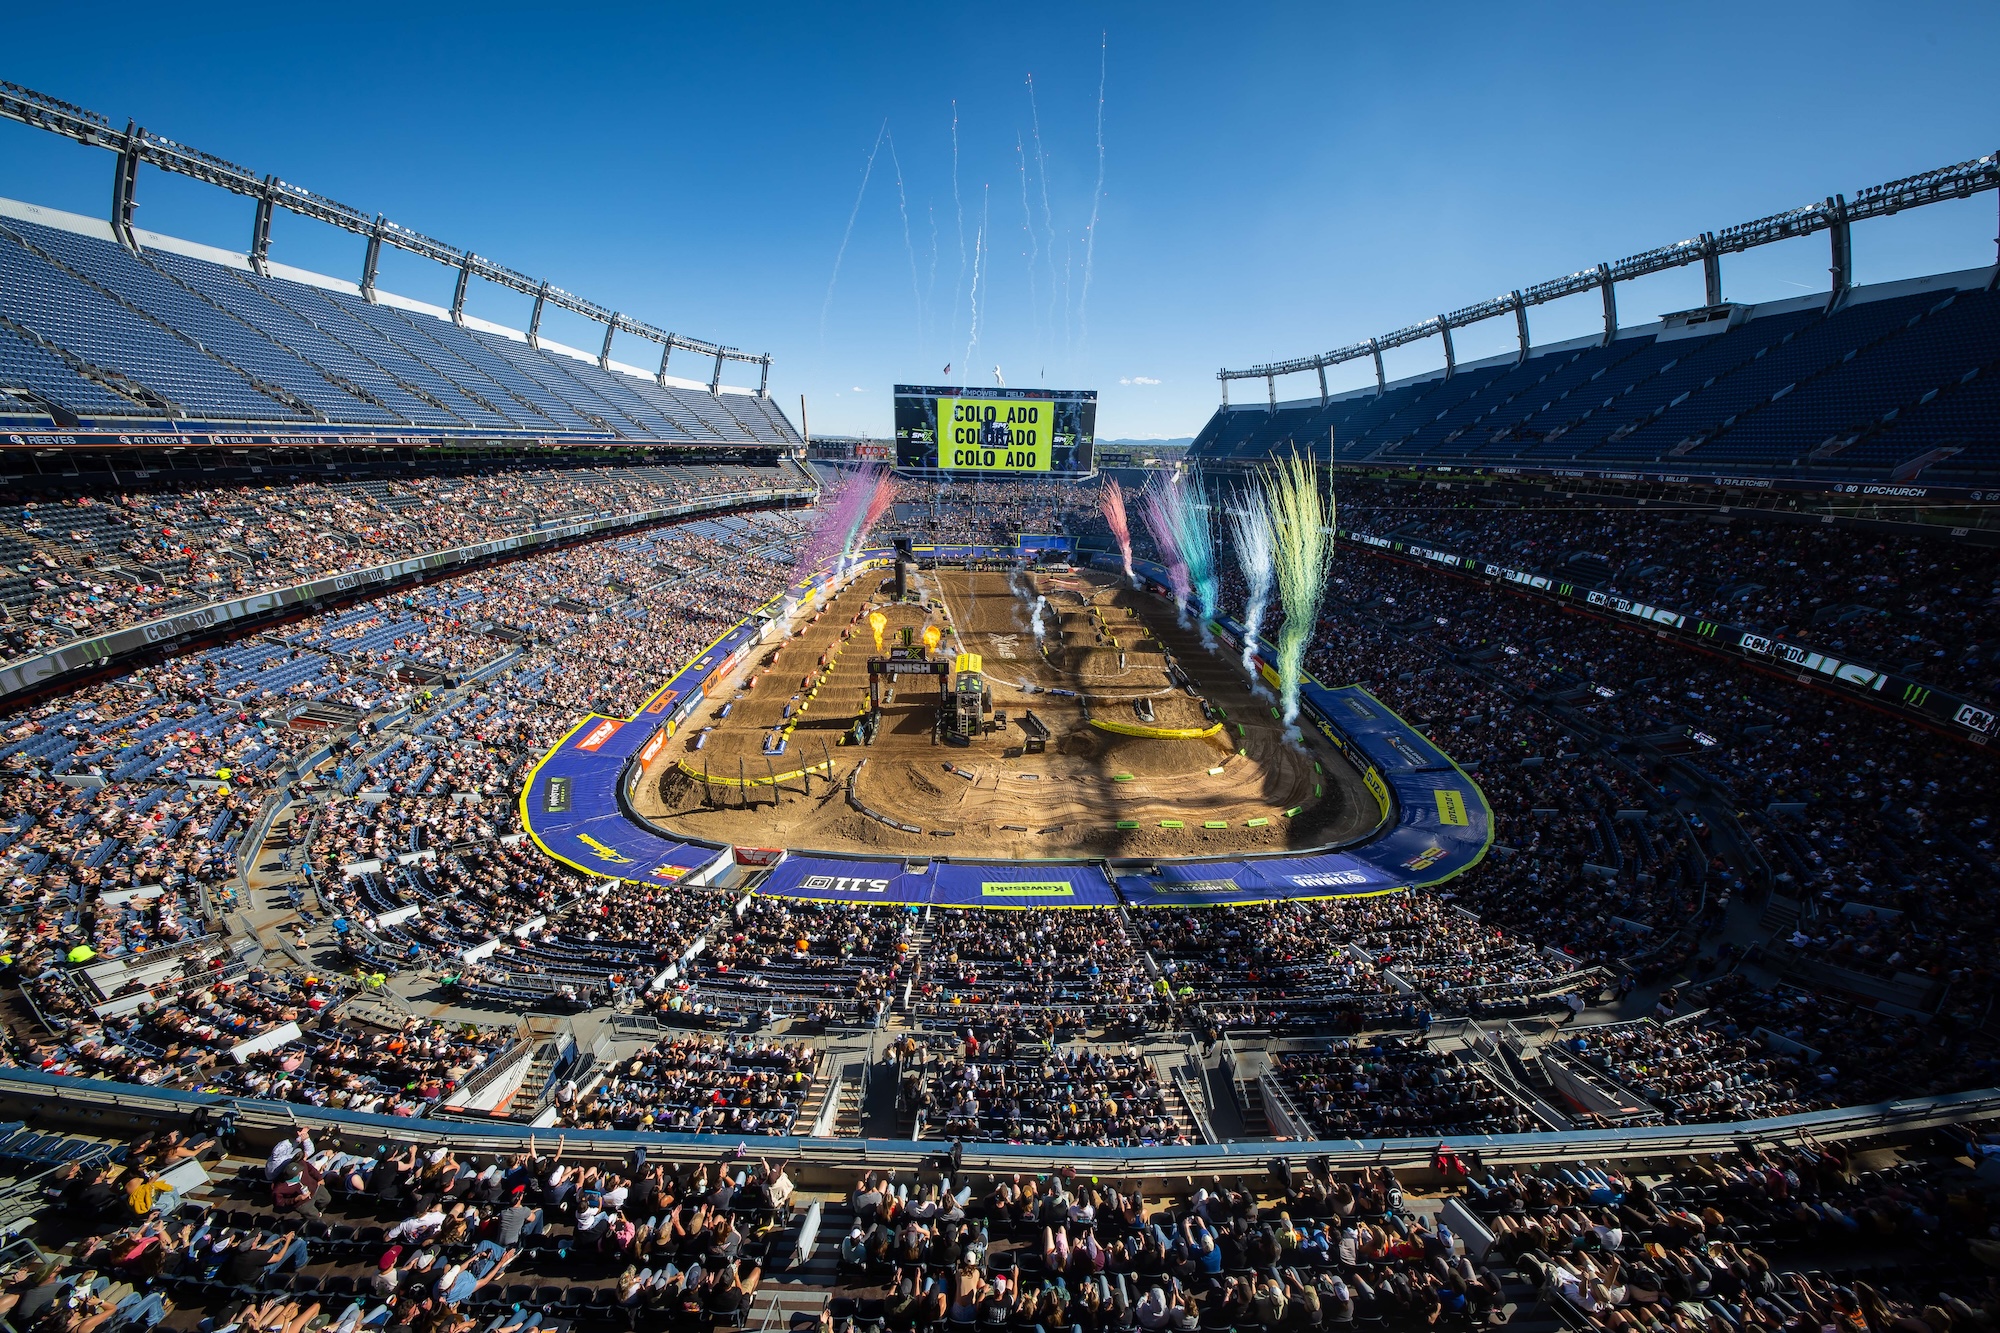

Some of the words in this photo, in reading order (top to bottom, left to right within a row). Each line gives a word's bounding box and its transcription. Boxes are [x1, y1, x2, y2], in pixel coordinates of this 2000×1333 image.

[962, 389, 998, 397] EMPOWER
[27, 436, 77, 445] REEVES
[133, 436, 144, 444] 47
[147, 436, 179, 445] LYNCH
[1731, 480, 1770, 488] FLETCHER
[1845, 485, 1858, 493] 80
[1863, 486, 1927, 497] UPCHURCH
[892, 647, 922, 660] SMX
[886, 663, 931, 674] FINISH
[1798, 675, 1810, 683] 109
[1970, 734, 1986, 743] 110
[550, 783, 560, 806] MONSTER
[1445, 796, 1458, 823] DUNLOP
[834, 876, 890, 893] 5.11
[1293, 876, 1354, 887] YAMAHA
[990, 885, 1065, 893] Kawasaki
[1391, 1192, 1402, 1206] T
